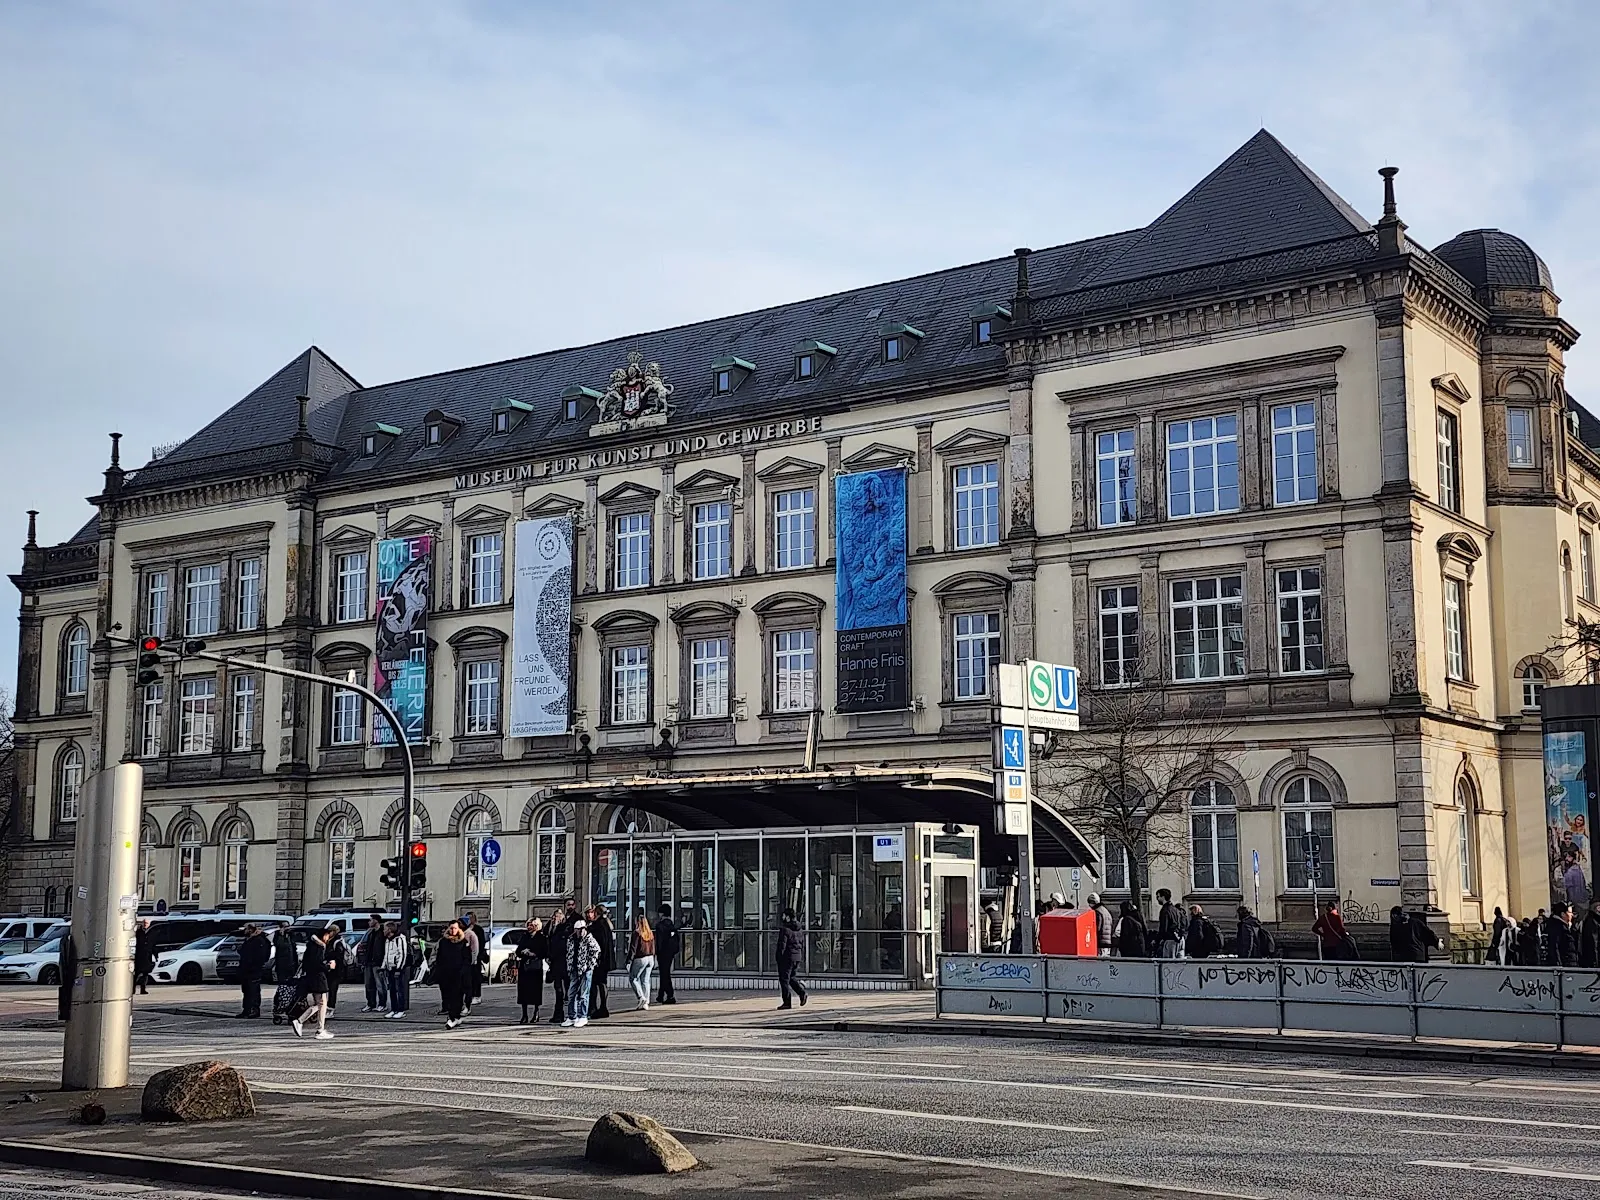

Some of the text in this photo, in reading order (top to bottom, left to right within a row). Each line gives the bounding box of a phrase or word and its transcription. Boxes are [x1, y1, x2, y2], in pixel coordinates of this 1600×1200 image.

[454, 416, 822, 489] MUSEUM FÜR KUNST UND GEWERBE
[840, 629, 903, 643] CONTEMPORARY
[840, 642, 865, 652] CRAFT
[518, 653, 539, 663] LASS
[840, 652, 905, 671] Hanne Friis
[528, 664, 544, 673] UNS
[514, 674, 551, 685] FREUNDE
[1031, 665, 1075, 707] S U
[524, 686, 560, 696] WERDEN
[840, 689, 885, 706] 27.4.25
[1030, 713, 1067, 726] Hauptbahnhof
[880, 838, 889, 846] U1
[1304, 966, 1328, 986] NO
